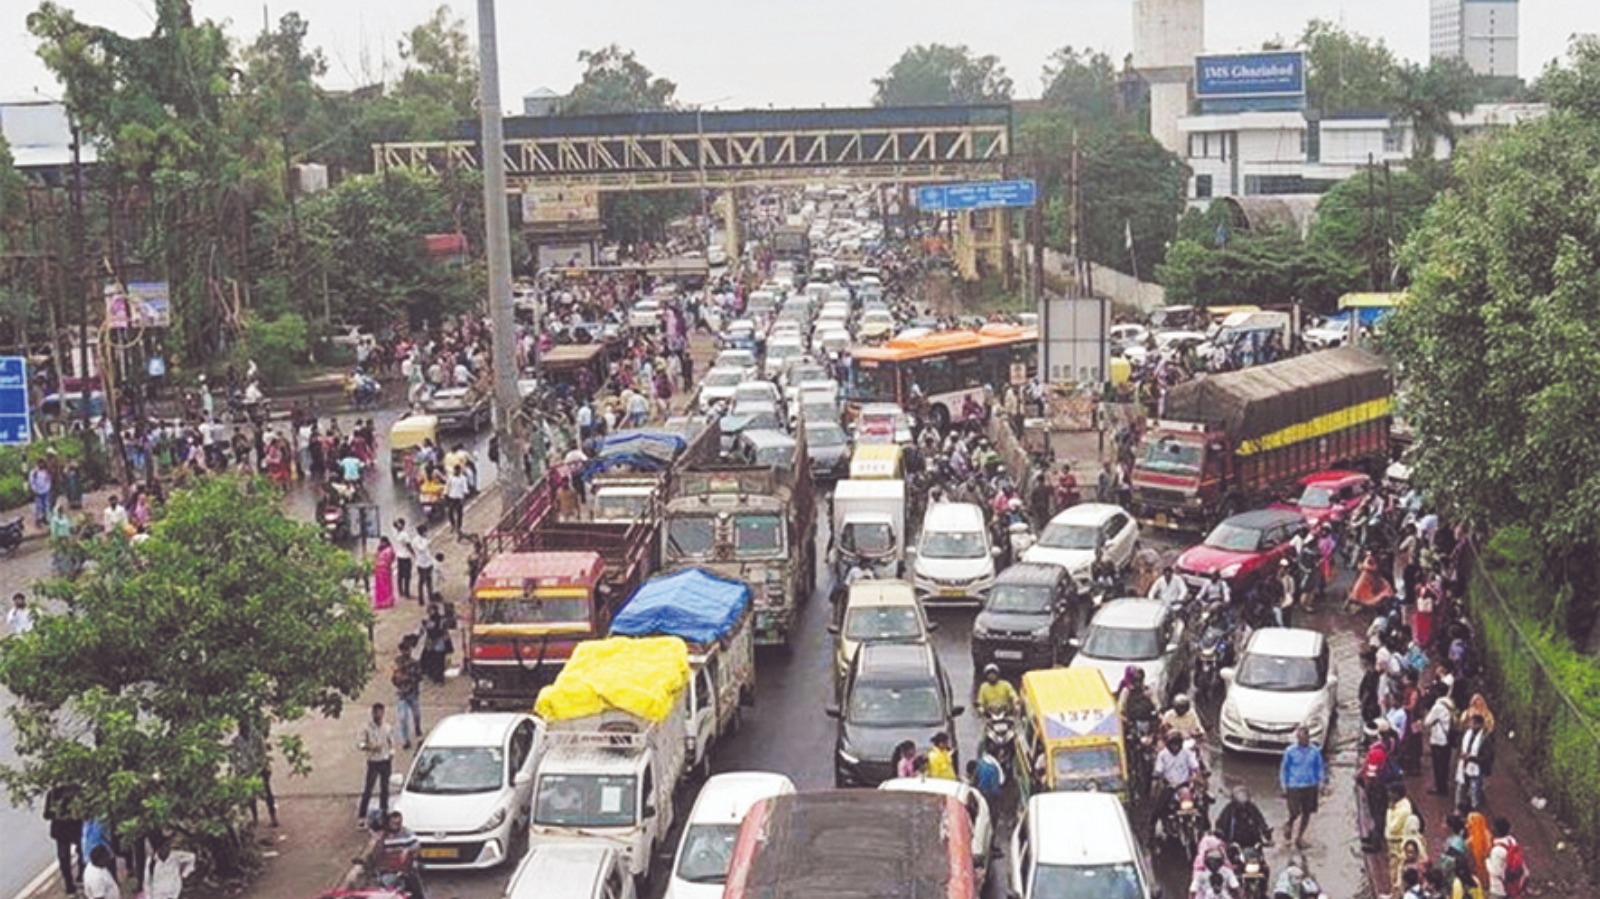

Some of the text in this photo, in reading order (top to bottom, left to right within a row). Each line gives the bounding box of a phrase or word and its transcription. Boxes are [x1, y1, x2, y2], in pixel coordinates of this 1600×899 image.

[1204, 63, 1294, 79] IMS Ghaziabad
[1060, 709, 1105, 722] 1375
